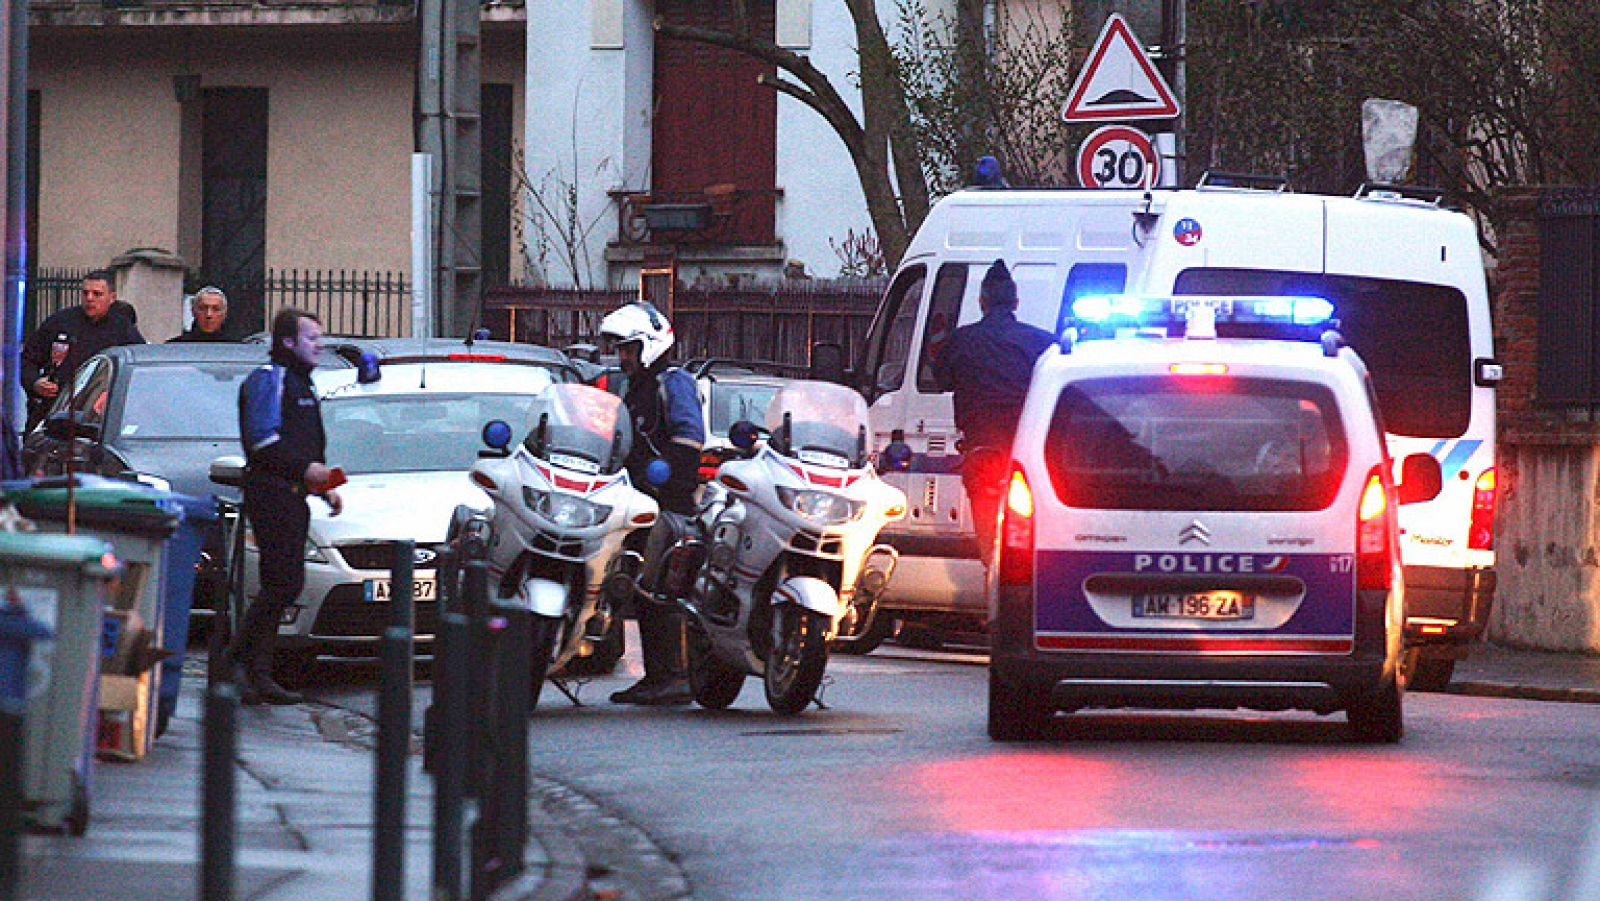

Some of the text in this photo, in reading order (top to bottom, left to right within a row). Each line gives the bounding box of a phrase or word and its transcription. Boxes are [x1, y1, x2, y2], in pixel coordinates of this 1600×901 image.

[1094, 148, 1143, 184] 30
[1134, 553, 1254, 573] POLICE
[1146, 594, 1239, 616] AW 196 ZA
